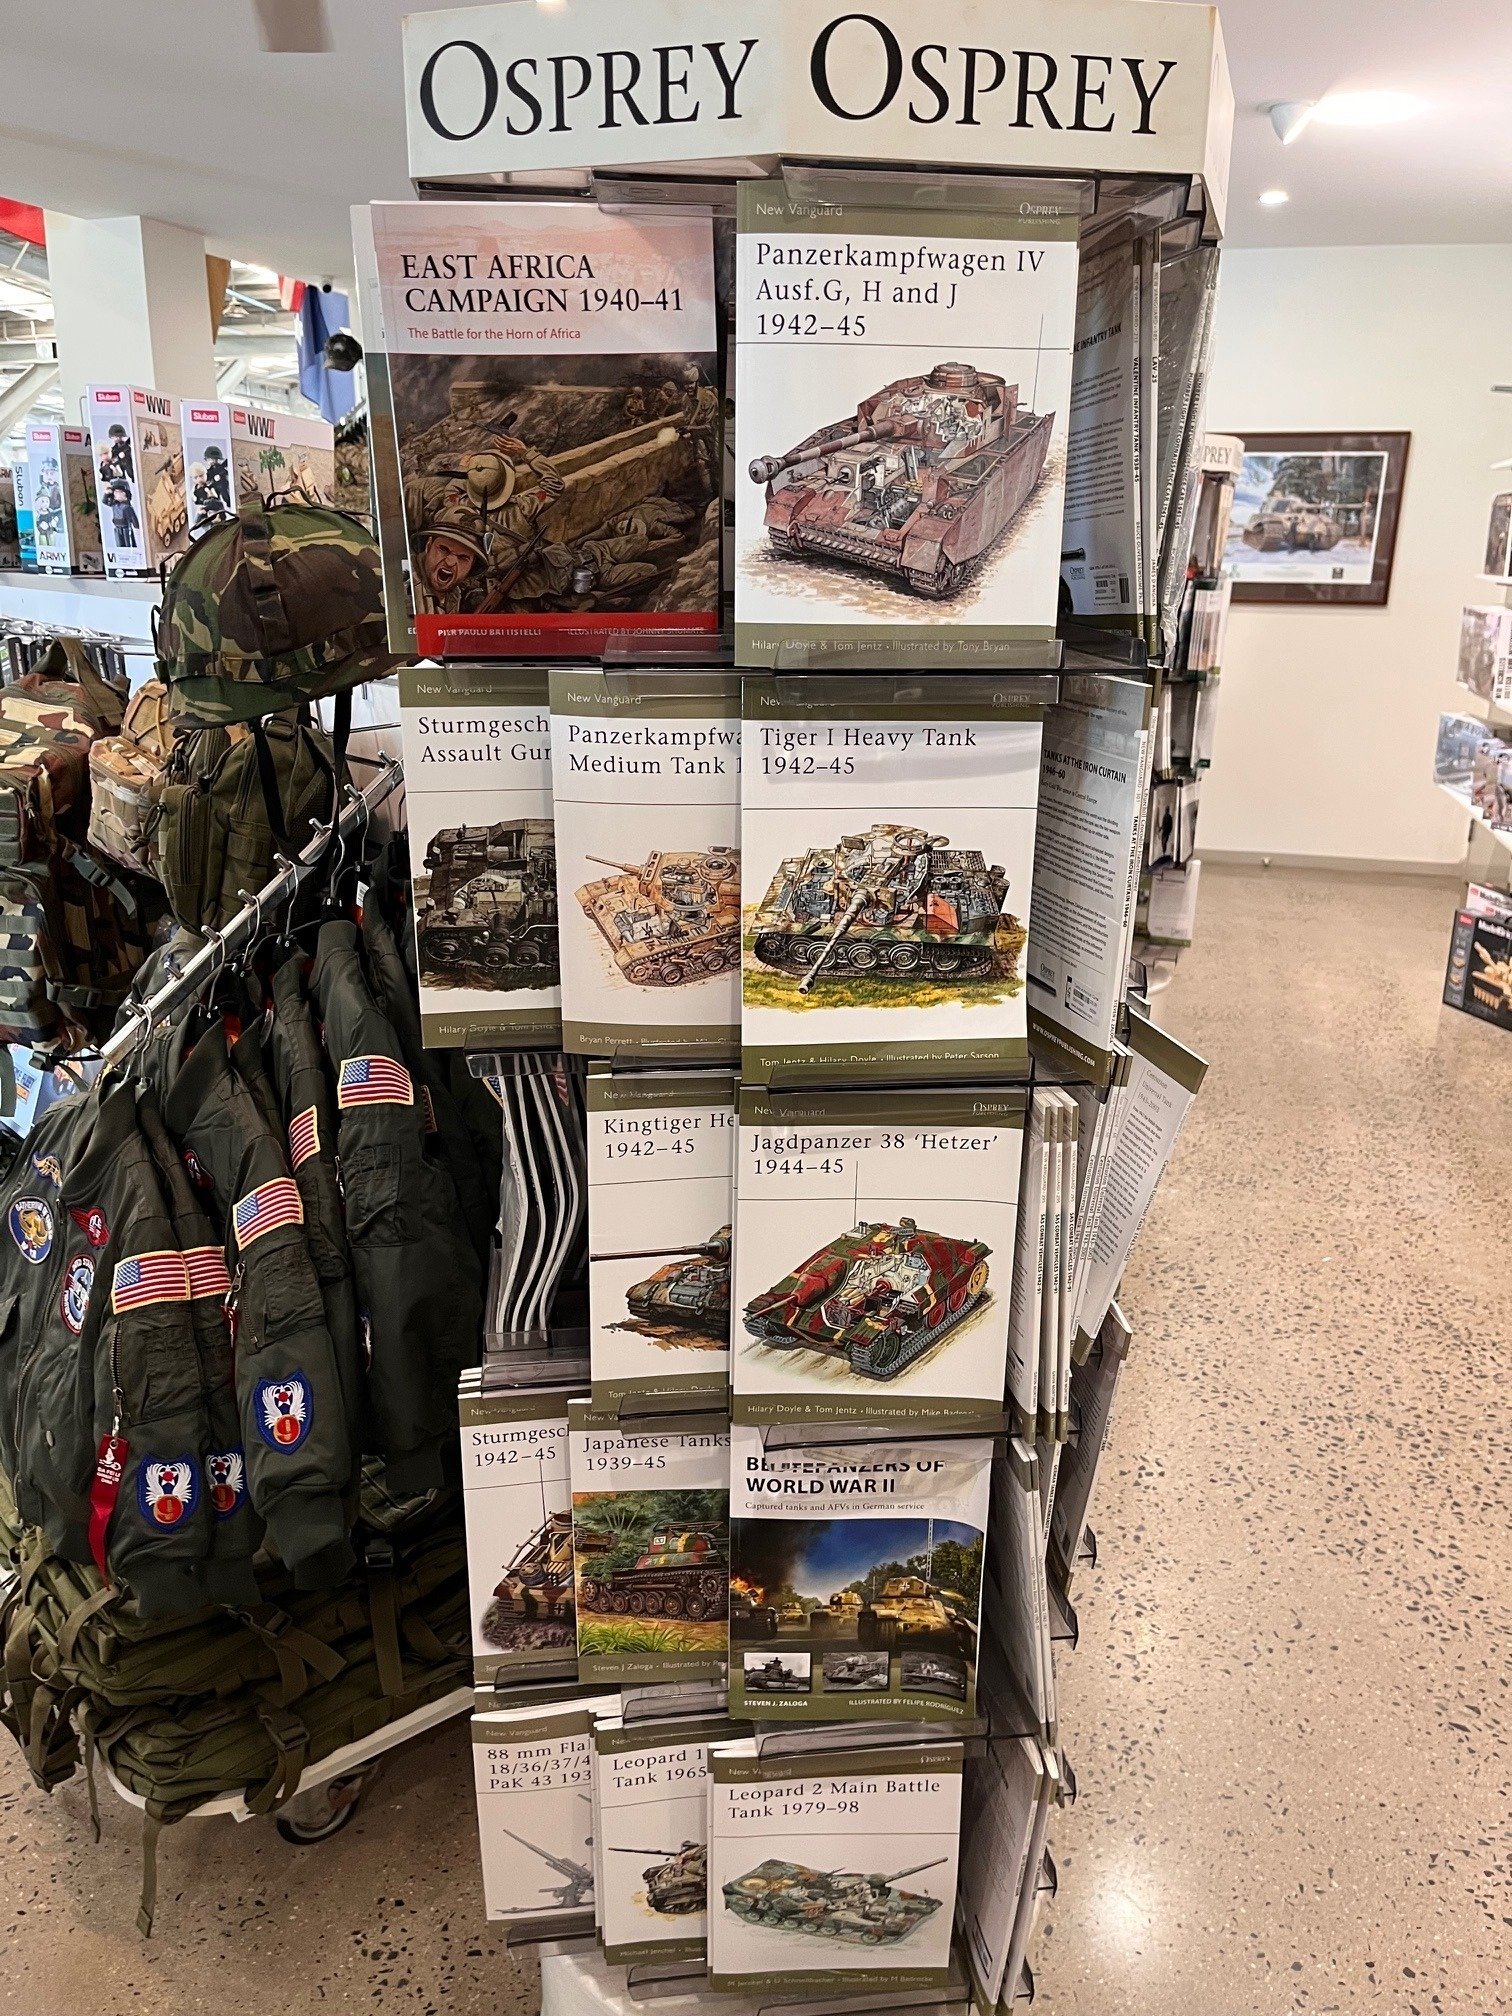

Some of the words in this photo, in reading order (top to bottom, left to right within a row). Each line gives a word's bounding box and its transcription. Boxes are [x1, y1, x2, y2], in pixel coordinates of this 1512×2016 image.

[809, 12, 1179, 136] OSPREY
[419, 38, 760, 142] OSPREY
[756, 203, 784, 216] New
[788, 203, 843, 219] Vanguard
[400, 253, 478, 280] EAST
[486, 253, 596, 280] AFRICA
[756, 242, 1006, 277] Panzerkampfwagen
[1017, 249, 1046, 272] IV
[404, 287, 568, 313] CAMPAIGN
[756, 278, 851, 306] Ausf.G,
[863, 280, 882, 302] H
[892, 282, 939, 304] and
[946, 282, 959, 309] J
[408, 327, 429, 340] The
[431, 327, 464, 340] Battle
[466, 327, 483, 340] for
[485, 327, 503, 340] the
[506, 328, 534, 340] Horn
[536, 327, 548, 340] of
[550, 327, 581, 340] Africa
[757, 313, 866, 337] 1942–45
[192, 411, 219, 421] Sluban
[14, 466, 24, 507] Sluban
[39, 551, 67, 562] ARMY
[416, 683, 442, 694] New
[567, 692, 591, 703] New
[594, 693, 642, 707] Vanguard
[418, 715, 550, 738] Sturmgesch
[760, 727, 818, 751] Tiger
[827, 728, 834, 746] I
[843, 728, 914, 751] Heavy
[922, 728, 977, 747] Tank
[420, 744, 502, 764] Assault
[568, 753, 661, 774] Medium
[671, 755, 725, 774] Tank
[761, 756, 856, 775] 1942–45
[1043, 748, 1064, 764] TANKS
[1062, 754, 1071, 766] AT
[1071, 758, 1083, 770] THE
[1082, 760, 1098, 776] IRON
[1098, 766, 1127, 784] CURTAIN
[579, 1034, 603, 1046] Bryan
[604, 1115, 702, 1136] Kingtiger
[605, 1137, 695, 1159] 1942–45
[750, 1133, 872, 1154] Jagdpanzer
[880, 1133, 905, 1149] 38
[754, 1158, 845, 1175] 1944–45
[583, 1413, 604, 1422] New
[776, 1404, 802, 1414] Doyle
[814, 1405, 833, 1414] Tom
[835, 1406, 857, 1415] Jentz
[865, 1406, 906, 1416] Illustrated
[908, 1408, 919, 1417] by
[472, 1424, 569, 1447] Sturmgesc
[583, 1435, 669, 1454] Japanese
[474, 1446, 556, 1467] 1942–45
[587, 1456, 666, 1472] 1939–45
[746, 1477, 825, 1495] WORLD
[829, 1478, 877, 1494] WAR
[883, 1478, 895, 1493] II
[745, 1501, 783, 1512] Captured
[785, 1503, 808, 1511] tanks
[810, 1503, 826, 1511] and
[827, 1503, 850, 1511] AFVs
[862, 1502, 895, 1511] German
[593, 1664, 621, 1672] Steven
[626, 1662, 653, 1672] Zaloga
[662, 1660, 699, 1670] Illustrated
[701, 1660, 711, 1670] by
[848, 1698, 891, 1706] ILLUSTRATED
[902, 1699, 926, 1707] FELIPE
[487, 1748, 509, 1760] 88
[517, 1746, 551, 1759] mm
[613, 1749, 687, 1772] Leopard
[697, 1749, 704, 1760] 1
[489, 1776, 523, 1790] PaK
[530, 1773, 552, 1786] 43
[612, 1770, 661, 1790] Tank
[666, 1766, 708, 1782] 1965
[729, 1783, 804, 1802] Leopard
[811, 1783, 823, 1795] 2
[830, 1781, 878, 1795] Main
[886, 1779, 941, 1793] Battle
[728, 1803, 774, 1819] Tank
[782, 1800, 860, 1816] 1979–98
